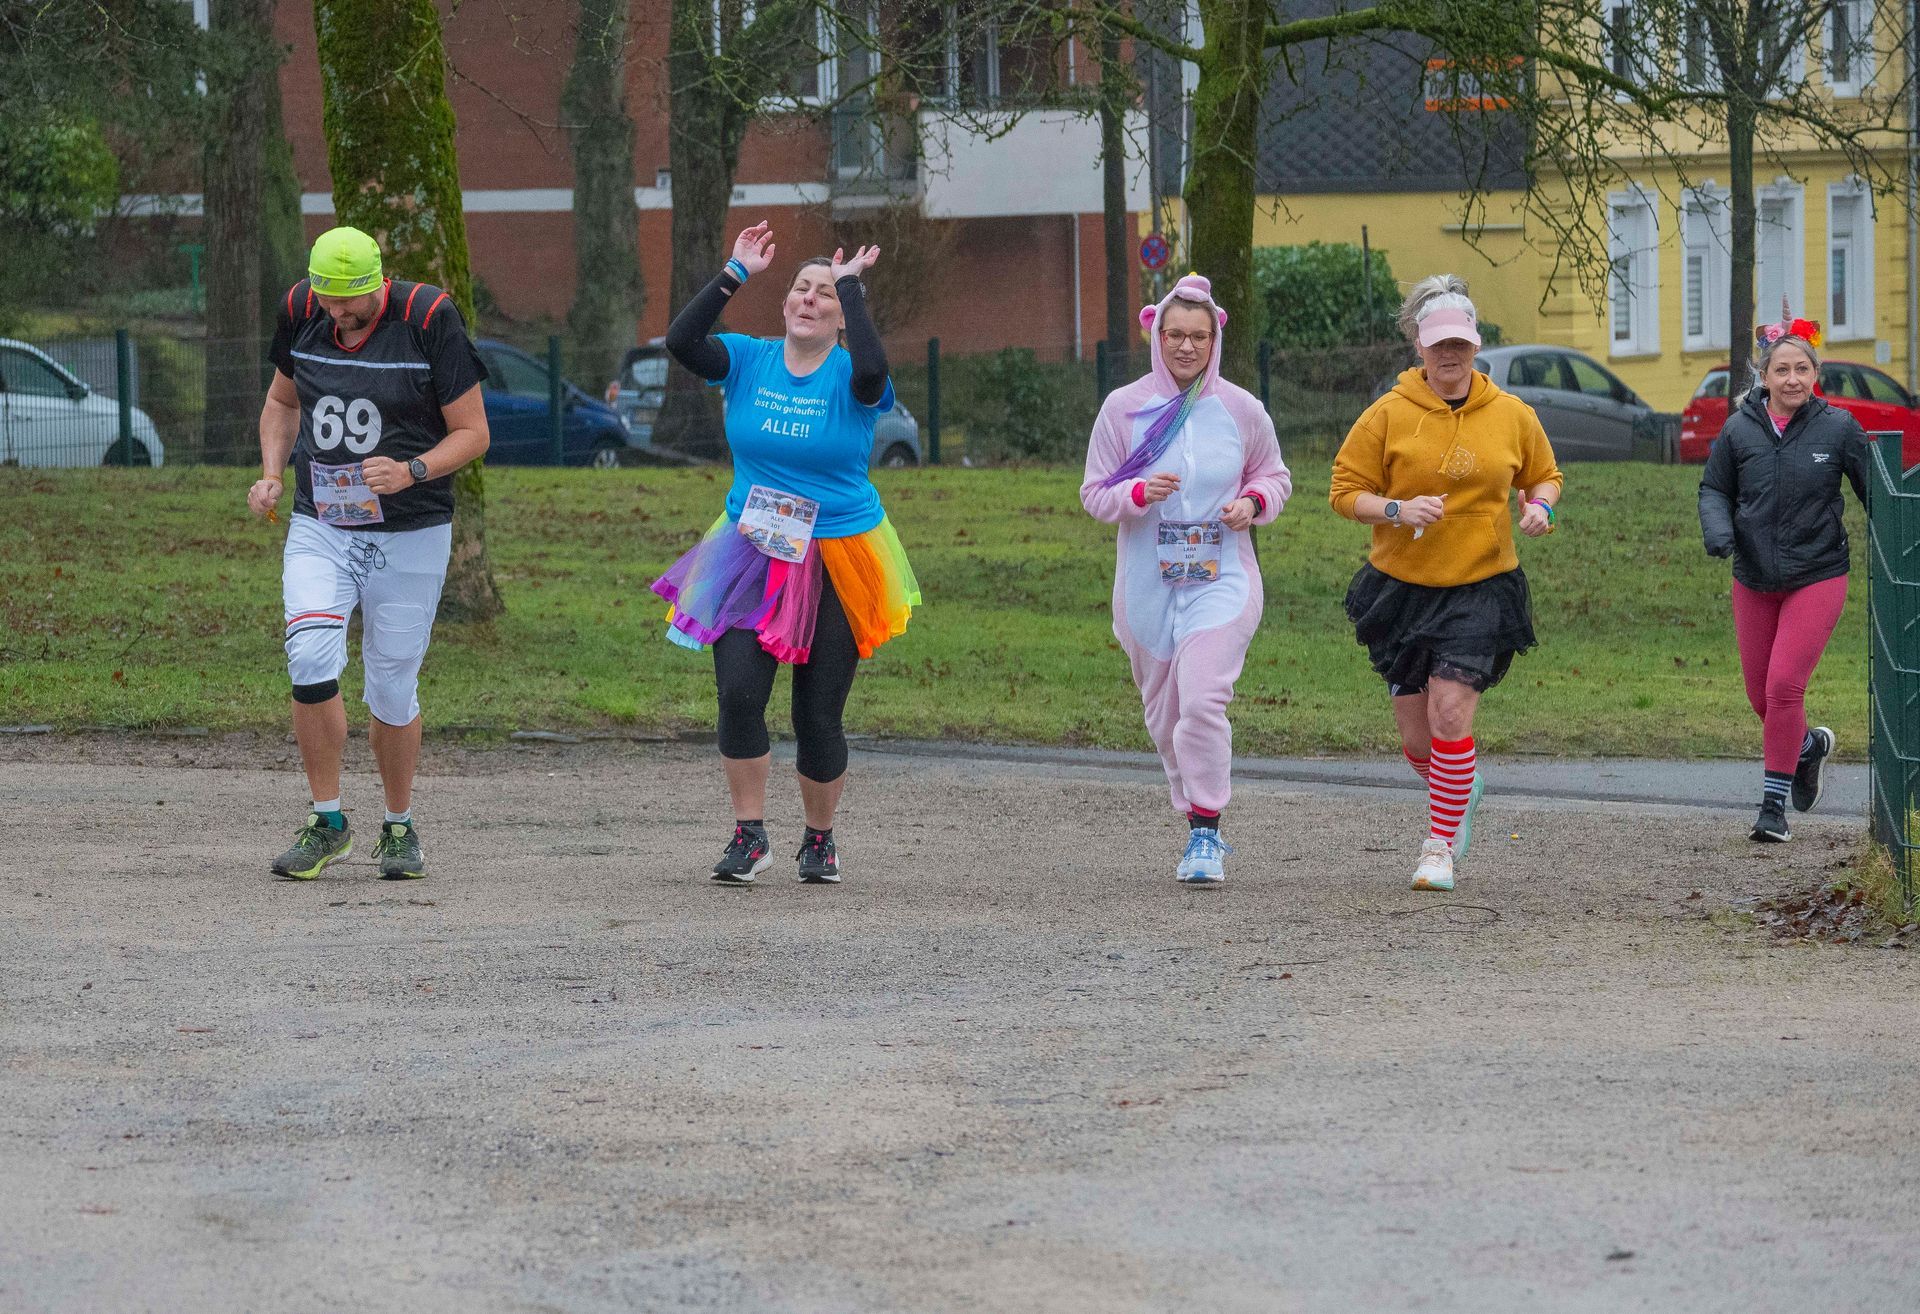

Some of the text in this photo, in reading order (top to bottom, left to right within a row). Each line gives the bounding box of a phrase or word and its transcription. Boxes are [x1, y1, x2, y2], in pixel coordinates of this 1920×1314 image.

[754, 398, 826, 417] bist Du gelaufen?
[312, 395, 382, 454] 69
[761, 418, 810, 438] ALLE!!
